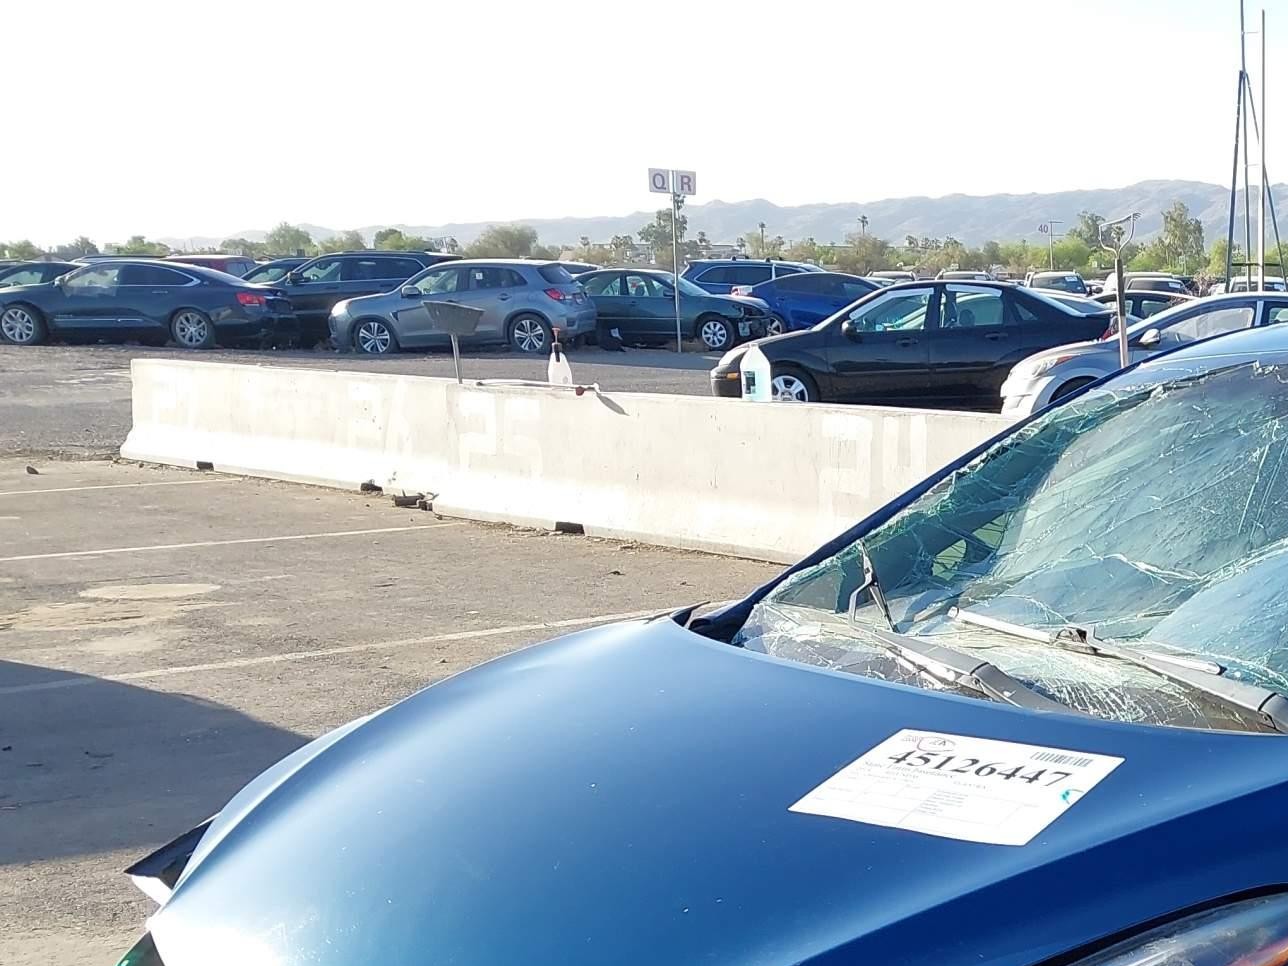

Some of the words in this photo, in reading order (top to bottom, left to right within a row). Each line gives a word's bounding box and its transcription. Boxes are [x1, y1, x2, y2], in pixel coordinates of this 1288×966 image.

[652, 172, 667, 191] Q
[680, 174, 692, 192] R
[1038, 223, 1049, 234] 40
[887, 749, 1073, 788] 45126447
